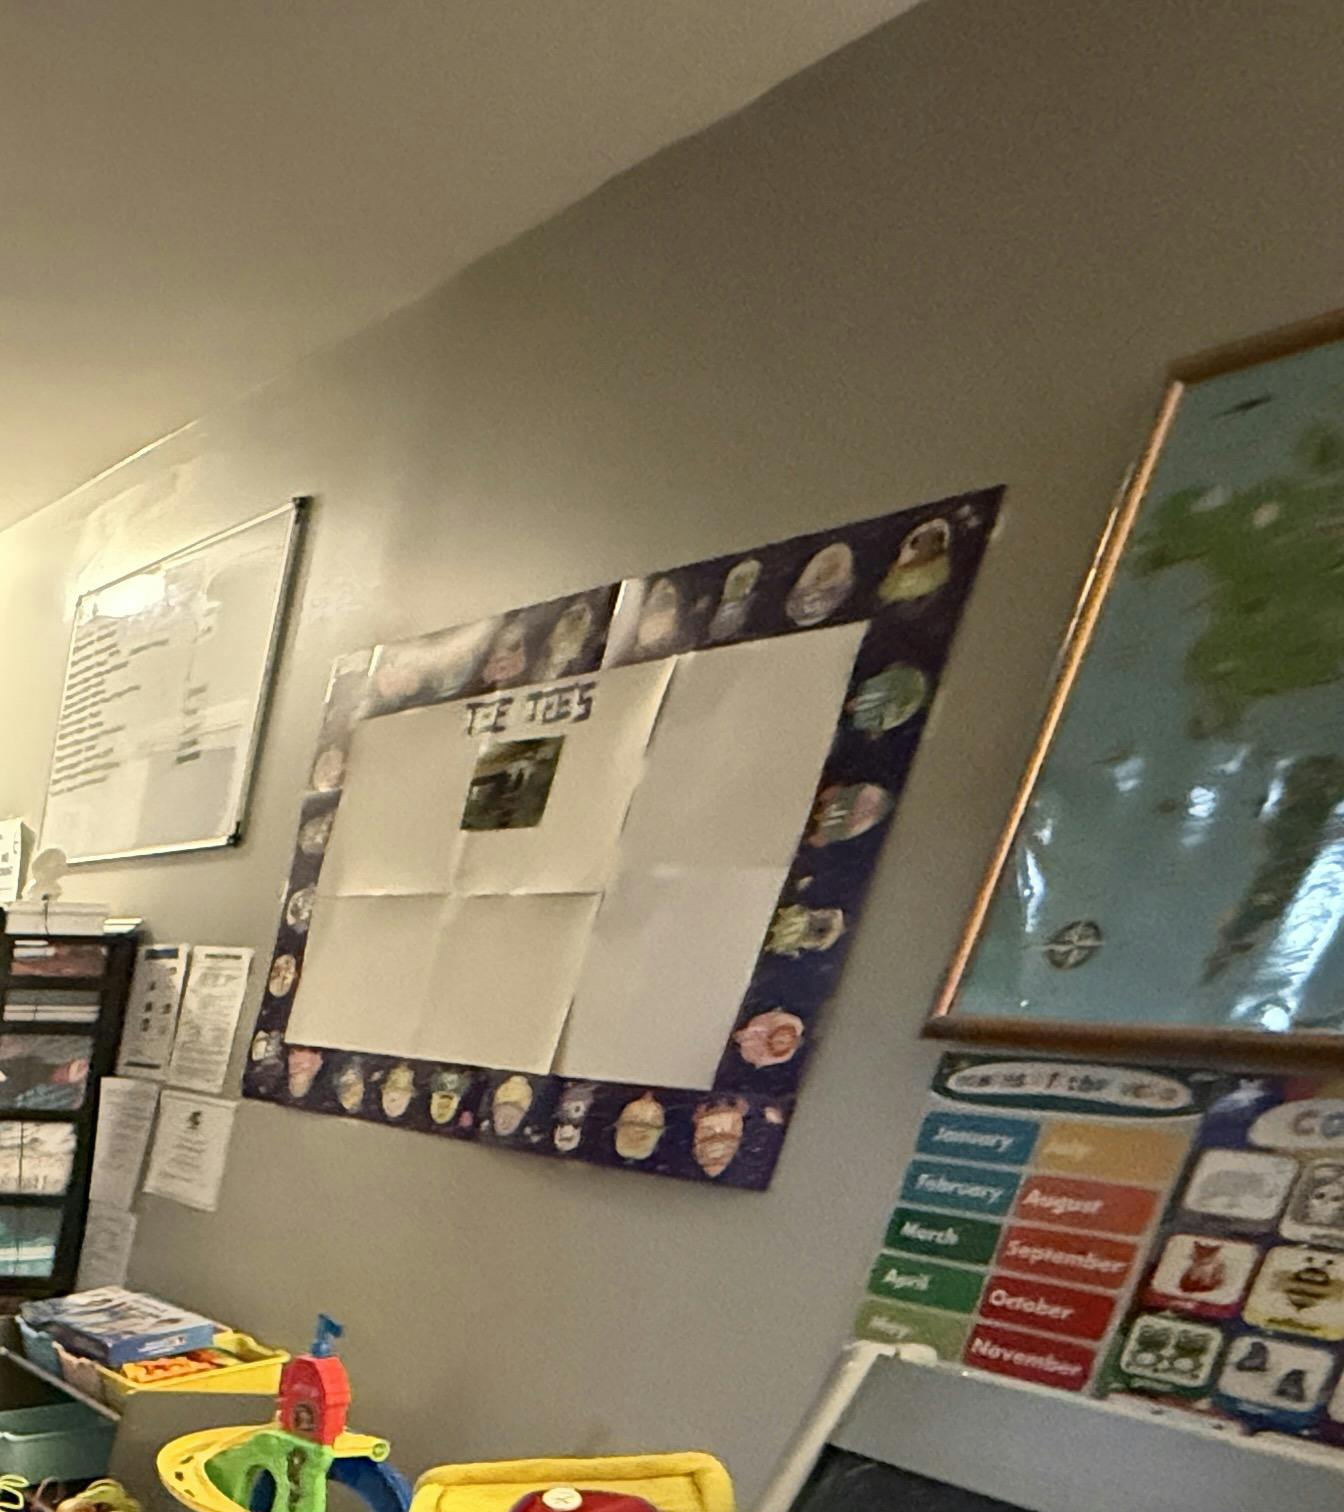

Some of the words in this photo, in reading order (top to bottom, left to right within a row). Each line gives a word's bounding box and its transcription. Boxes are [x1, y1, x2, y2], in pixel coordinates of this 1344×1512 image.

[932, 1125, 1015, 1151] January
[915, 1173, 1004, 1205] February
[1022, 1188, 1106, 1215] August
[899, 1221, 960, 1246] March
[1006, 1240, 1128, 1274] September
[882, 1268, 931, 1292] April
[989, 1288, 1076, 1320] October
[970, 1337, 1084, 1377] November
